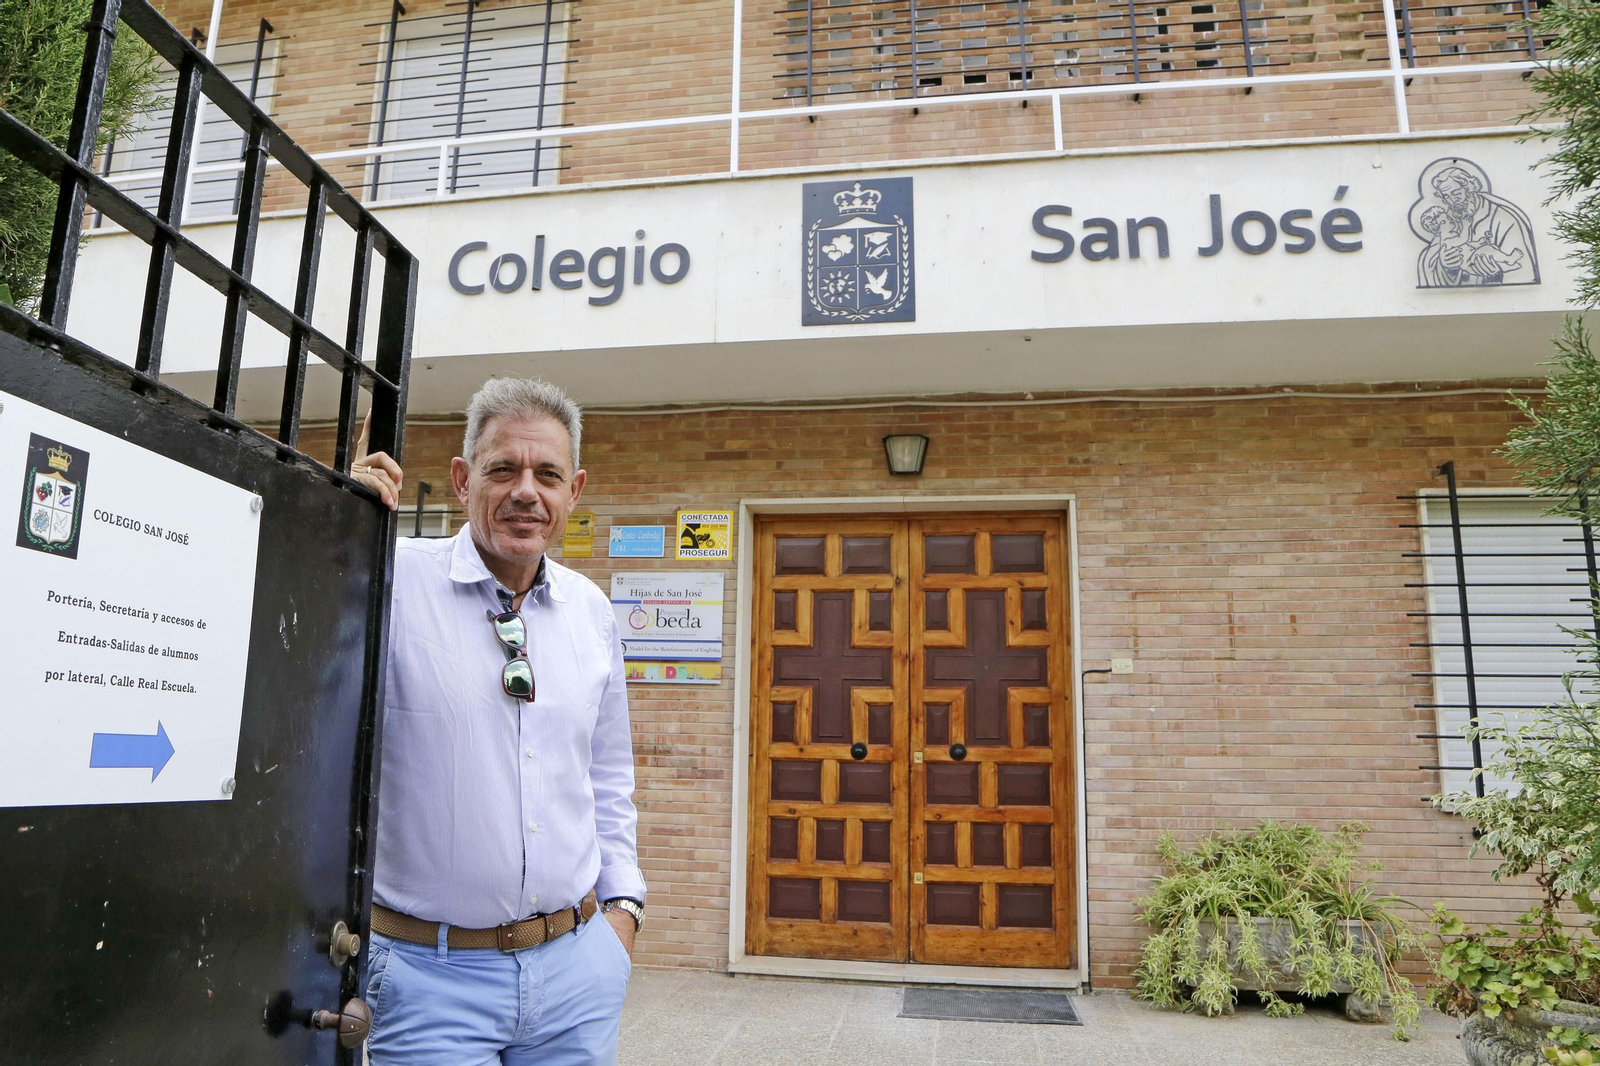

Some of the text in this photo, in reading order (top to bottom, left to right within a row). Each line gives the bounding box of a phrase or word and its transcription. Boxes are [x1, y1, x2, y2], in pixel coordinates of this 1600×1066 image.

[448, 185, 1363, 306] Colegio San José
[93, 509, 190, 546] COLEGIO SAN JOSÉ
[630, 588, 703, 598] Hijas de San José
[47, 590, 207, 630] Portería, Secretaría y accesos de
[656, 608, 702, 629] beda
[57, 631, 199, 661] Entradas-Salidas de alumnos
[45, 670, 197, 694] por lateral, Calle Real Escuela.
